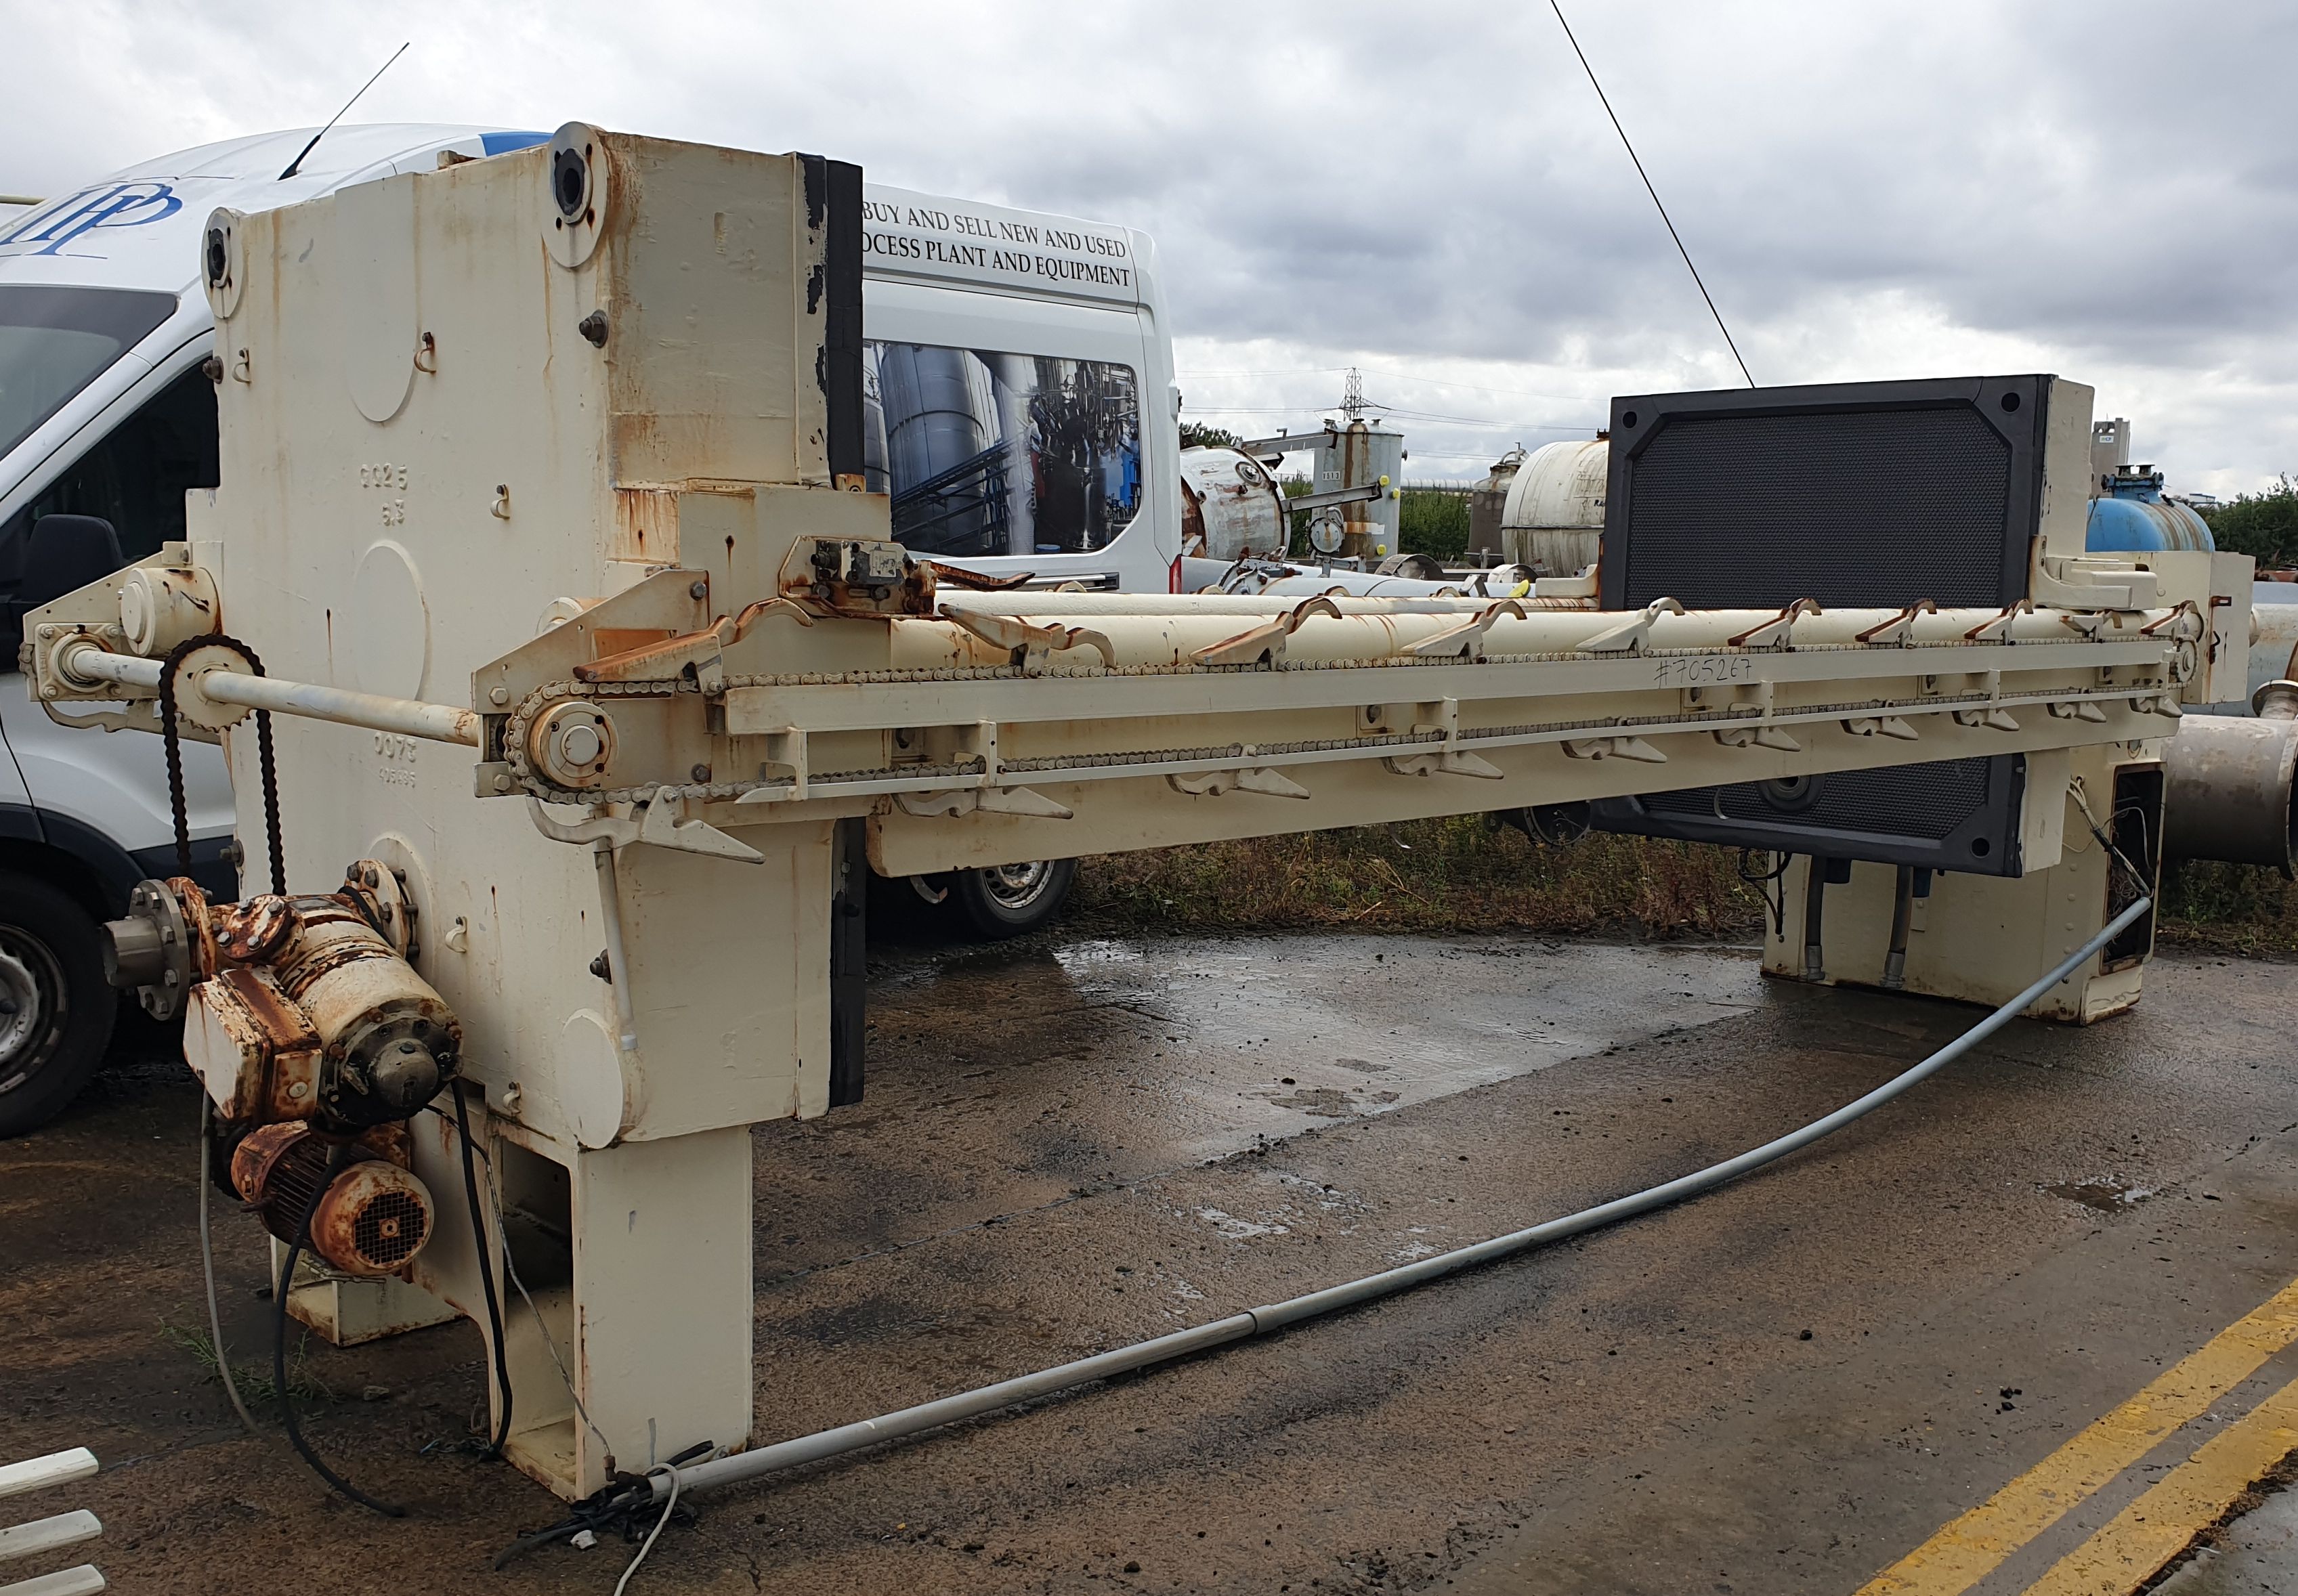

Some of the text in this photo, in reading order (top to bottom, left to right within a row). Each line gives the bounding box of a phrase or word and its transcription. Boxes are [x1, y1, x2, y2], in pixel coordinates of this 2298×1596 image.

[863, 202, 1126, 258] BUY AND SELL NEW AND USED
[925, 240, 987, 267] PLANT
[992, 250, 1031, 273] AND
[1035, 256, 1130, 286] EQUIPMENT
[1653, 657, 1752, 689] #705267
